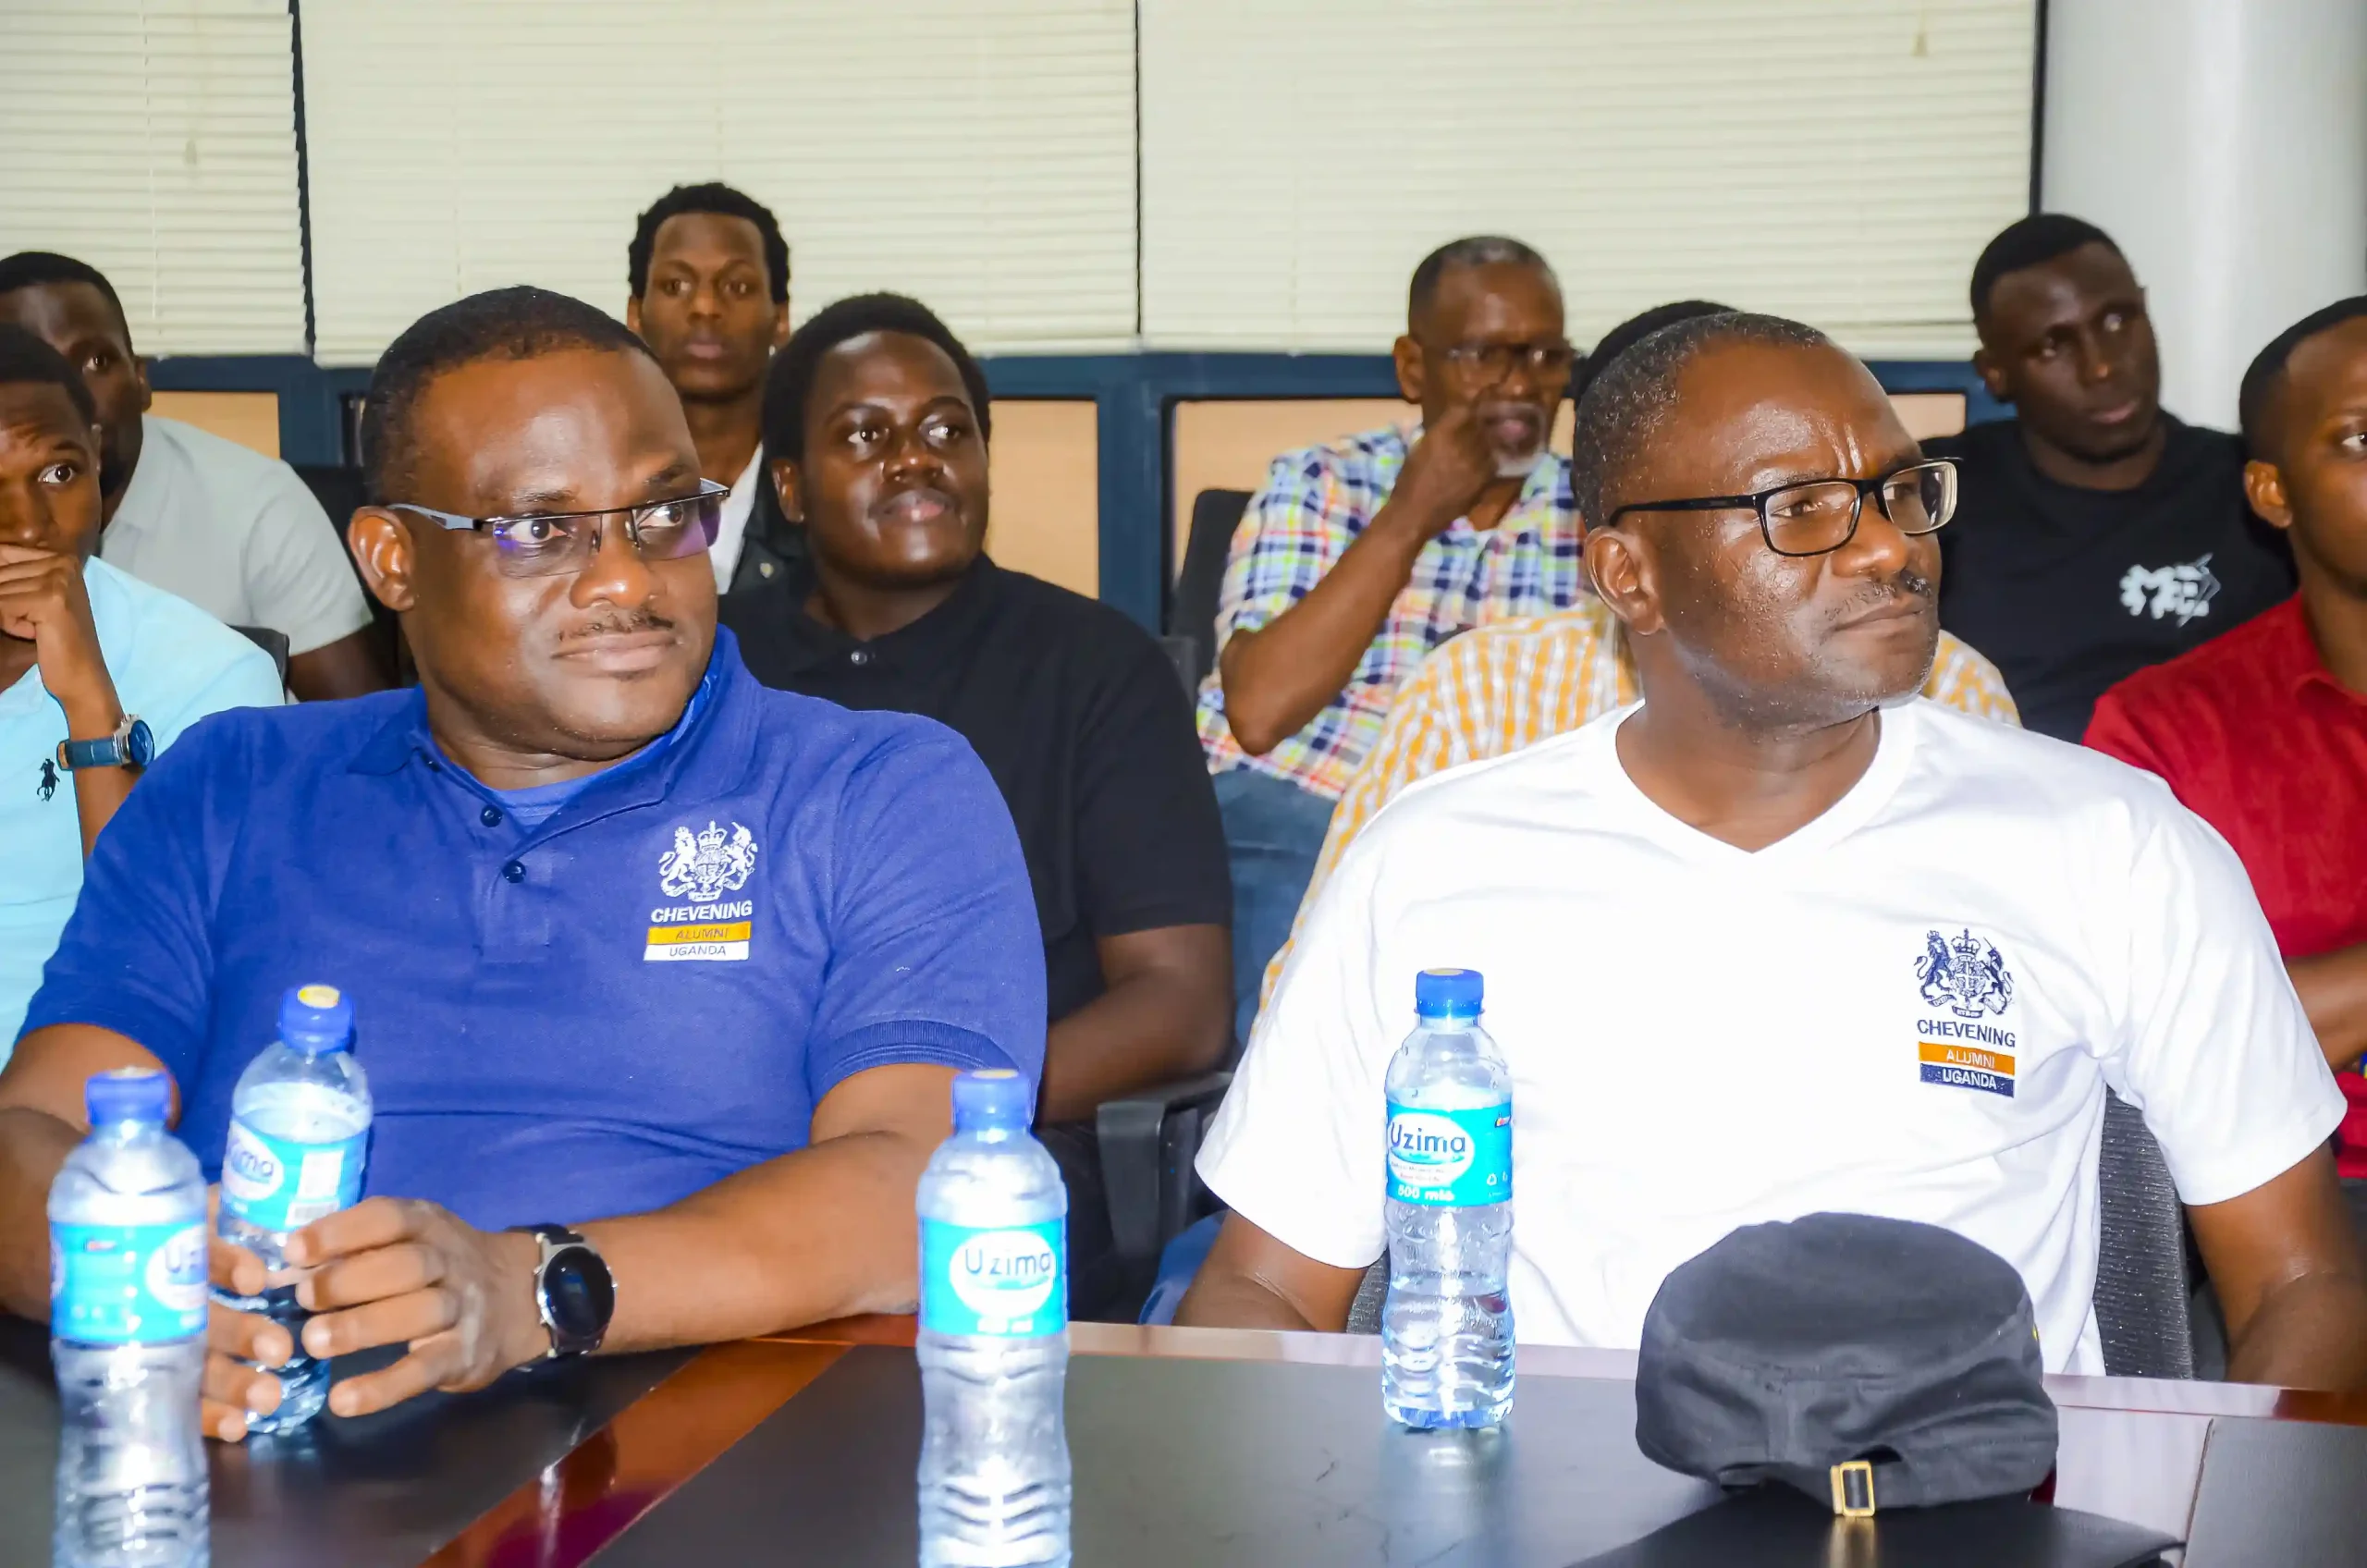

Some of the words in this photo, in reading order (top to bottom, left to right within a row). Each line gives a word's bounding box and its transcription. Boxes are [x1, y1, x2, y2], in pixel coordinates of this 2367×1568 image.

[651, 900, 753, 923] CHEVENING
[676, 928, 729, 940] ALUMNI
[669, 946, 726, 956] UGANDA
[1916, 1019, 2016, 1047] CHEVENING
[1946, 1050, 1994, 1068] ALUMNI
[1943, 1069, 1997, 1089] UGANDA
[1391, 1122, 1466, 1153] Uzima
[1397, 1184, 1420, 1199] 500
[964, 1248, 1051, 1276] Uzima
